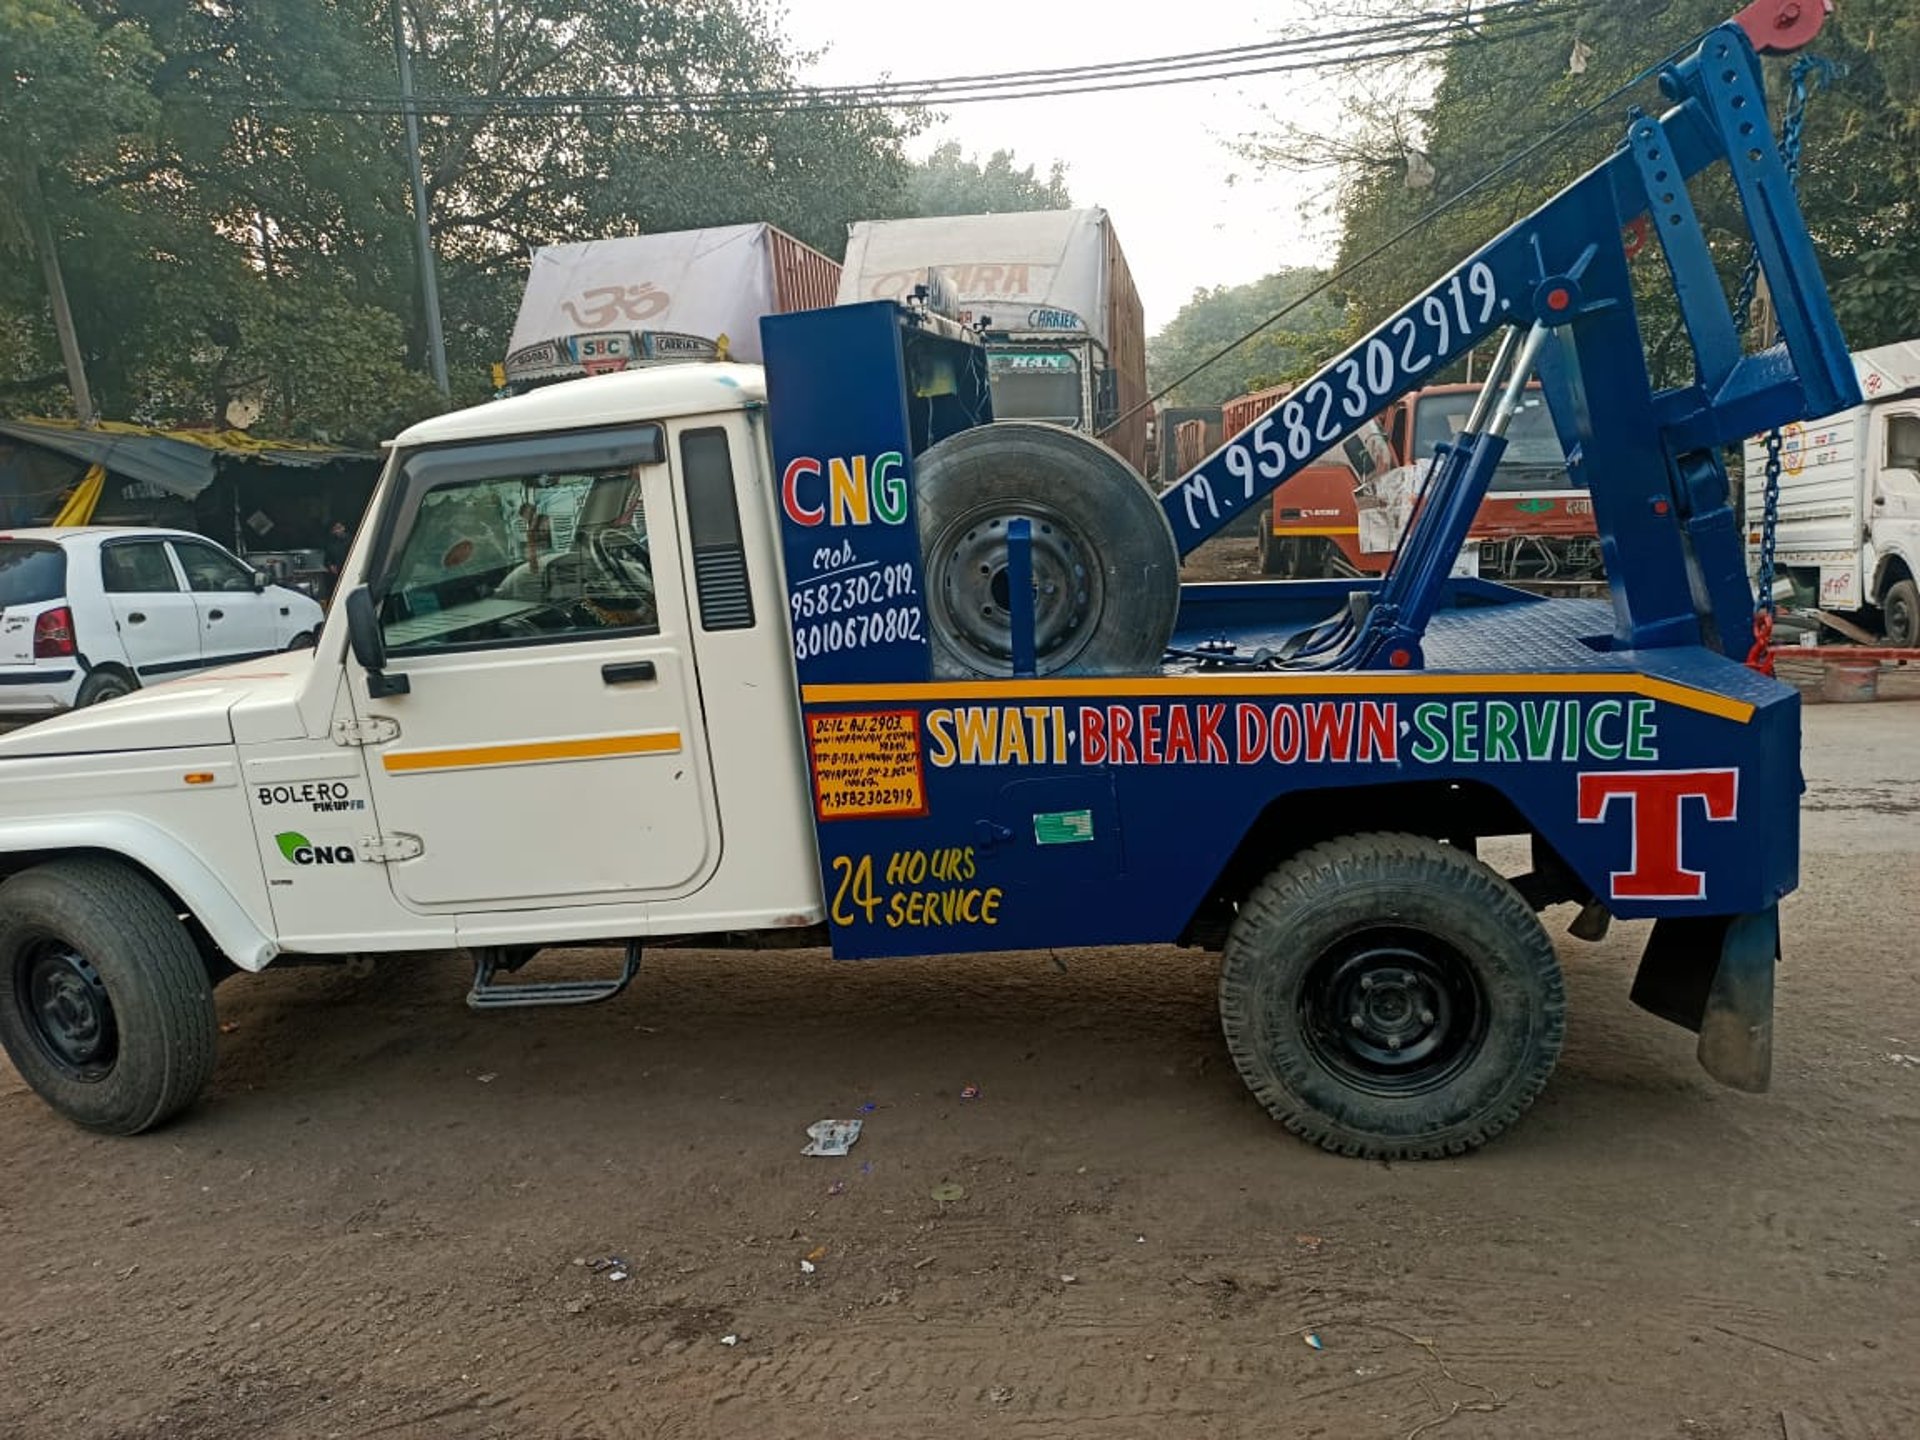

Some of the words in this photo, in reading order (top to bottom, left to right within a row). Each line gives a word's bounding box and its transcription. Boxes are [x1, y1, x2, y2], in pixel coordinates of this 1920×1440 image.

[1027, 309, 1079, 329] CARRIER
[583, 339, 621, 357] SBC
[781, 451, 908, 527] CNG
[795, 606, 927, 660] 8010670802.
[1079, 703, 1229, 765] BREAK
[1236, 701, 1398, 764] DOWN
[1411, 699, 1660, 763] SERVICE
[258, 783, 349, 805] BOLERO
[294, 846, 356, 864] CNG
[1577, 767, 1739, 899] T
[831, 854, 883, 926] 24
[886, 846, 976, 884] HOURS
[886, 887, 1003, 928] SERVICE
